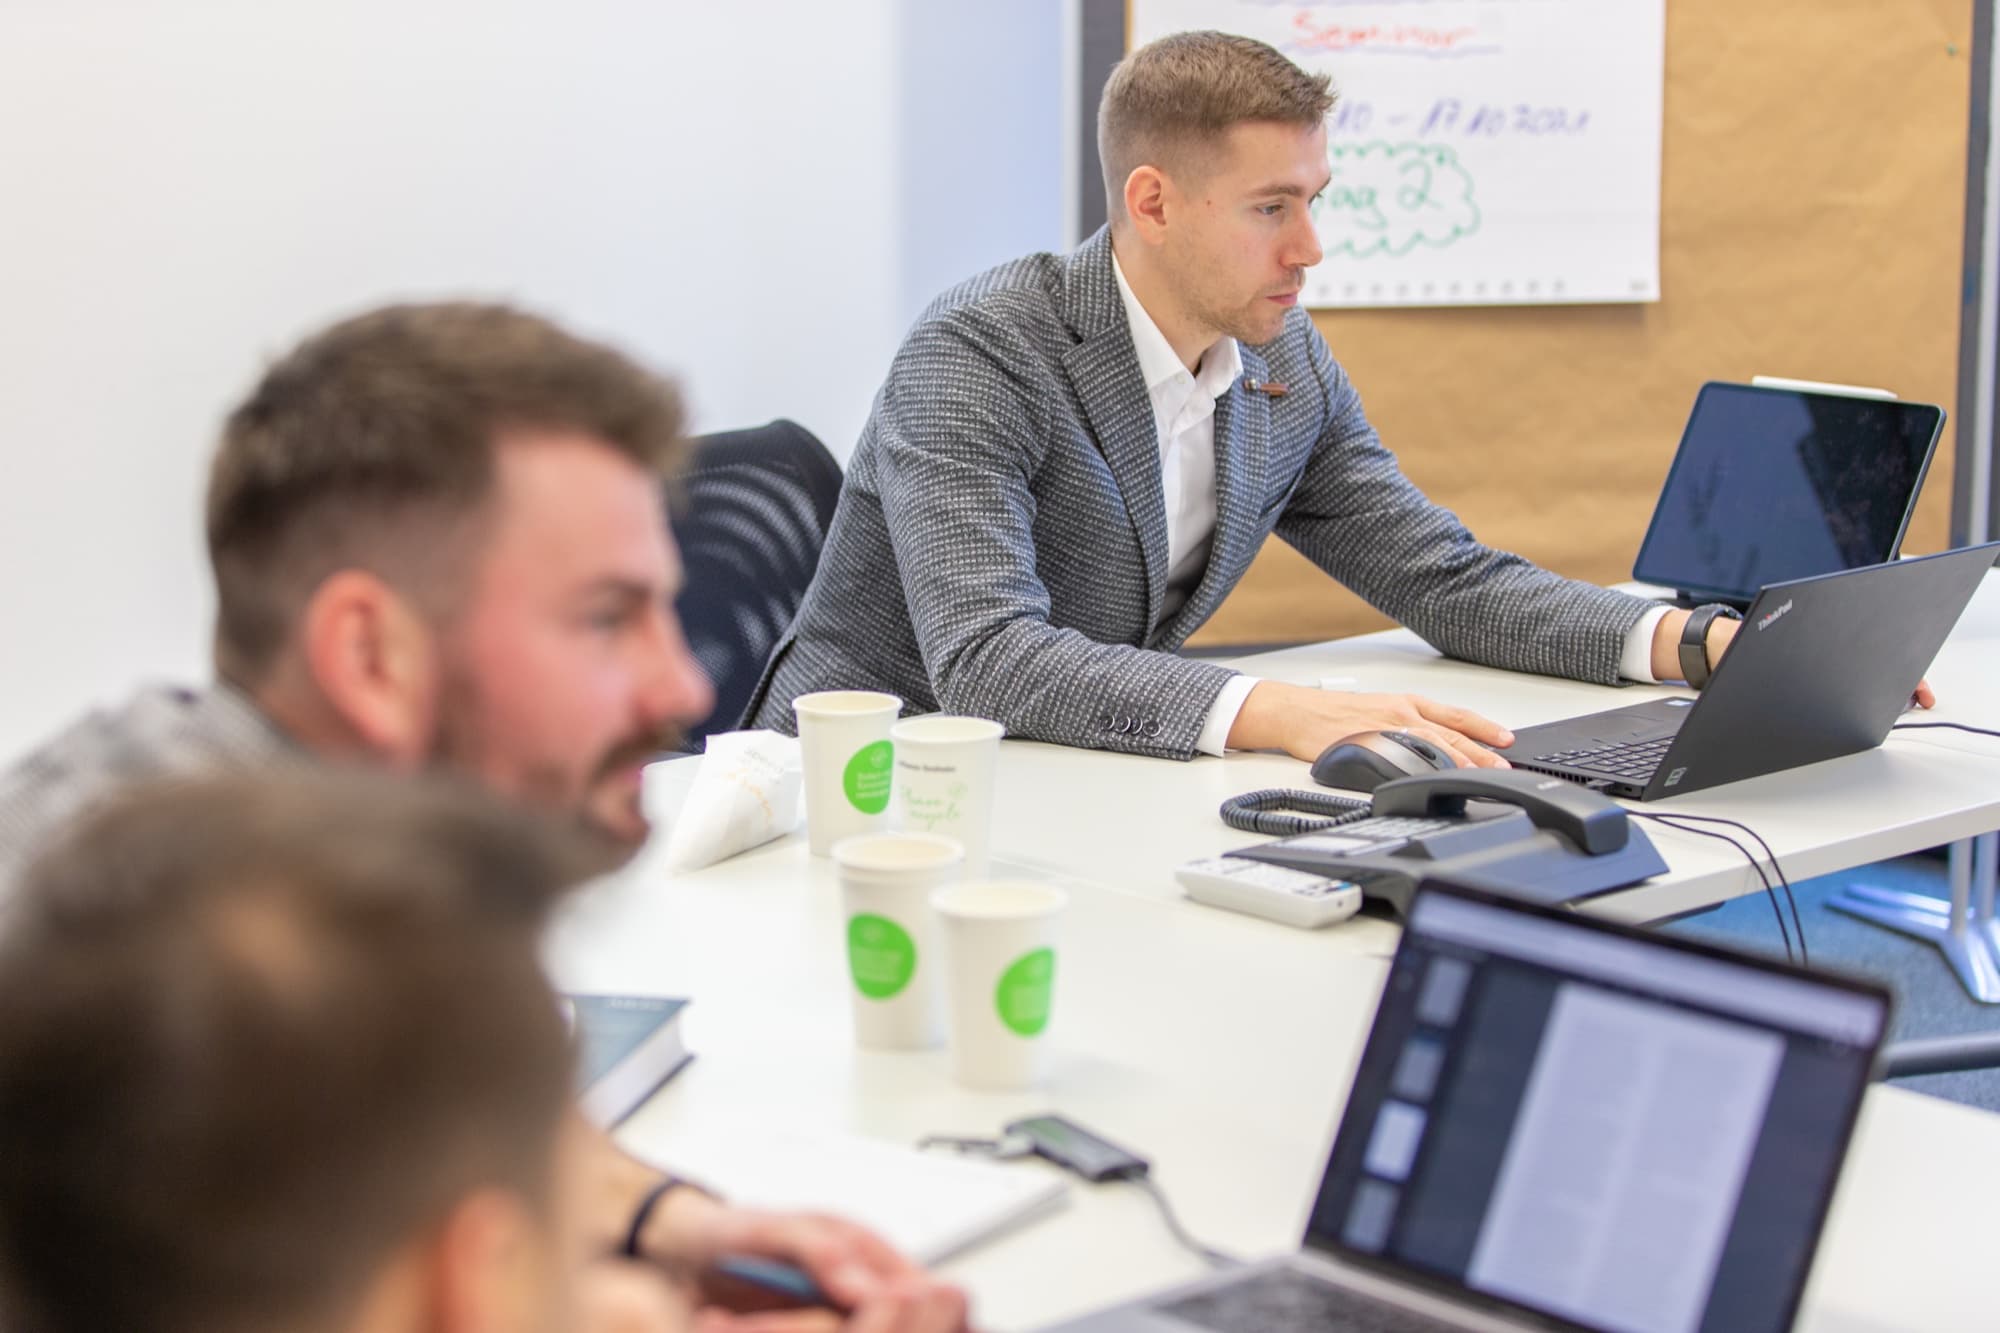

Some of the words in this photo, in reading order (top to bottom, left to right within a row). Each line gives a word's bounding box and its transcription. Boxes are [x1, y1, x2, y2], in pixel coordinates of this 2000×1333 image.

[1313, 166, 1388, 231] ag
[1397, 158, 1445, 213] 2
[1758, 599, 1793, 631] ThinkPad
